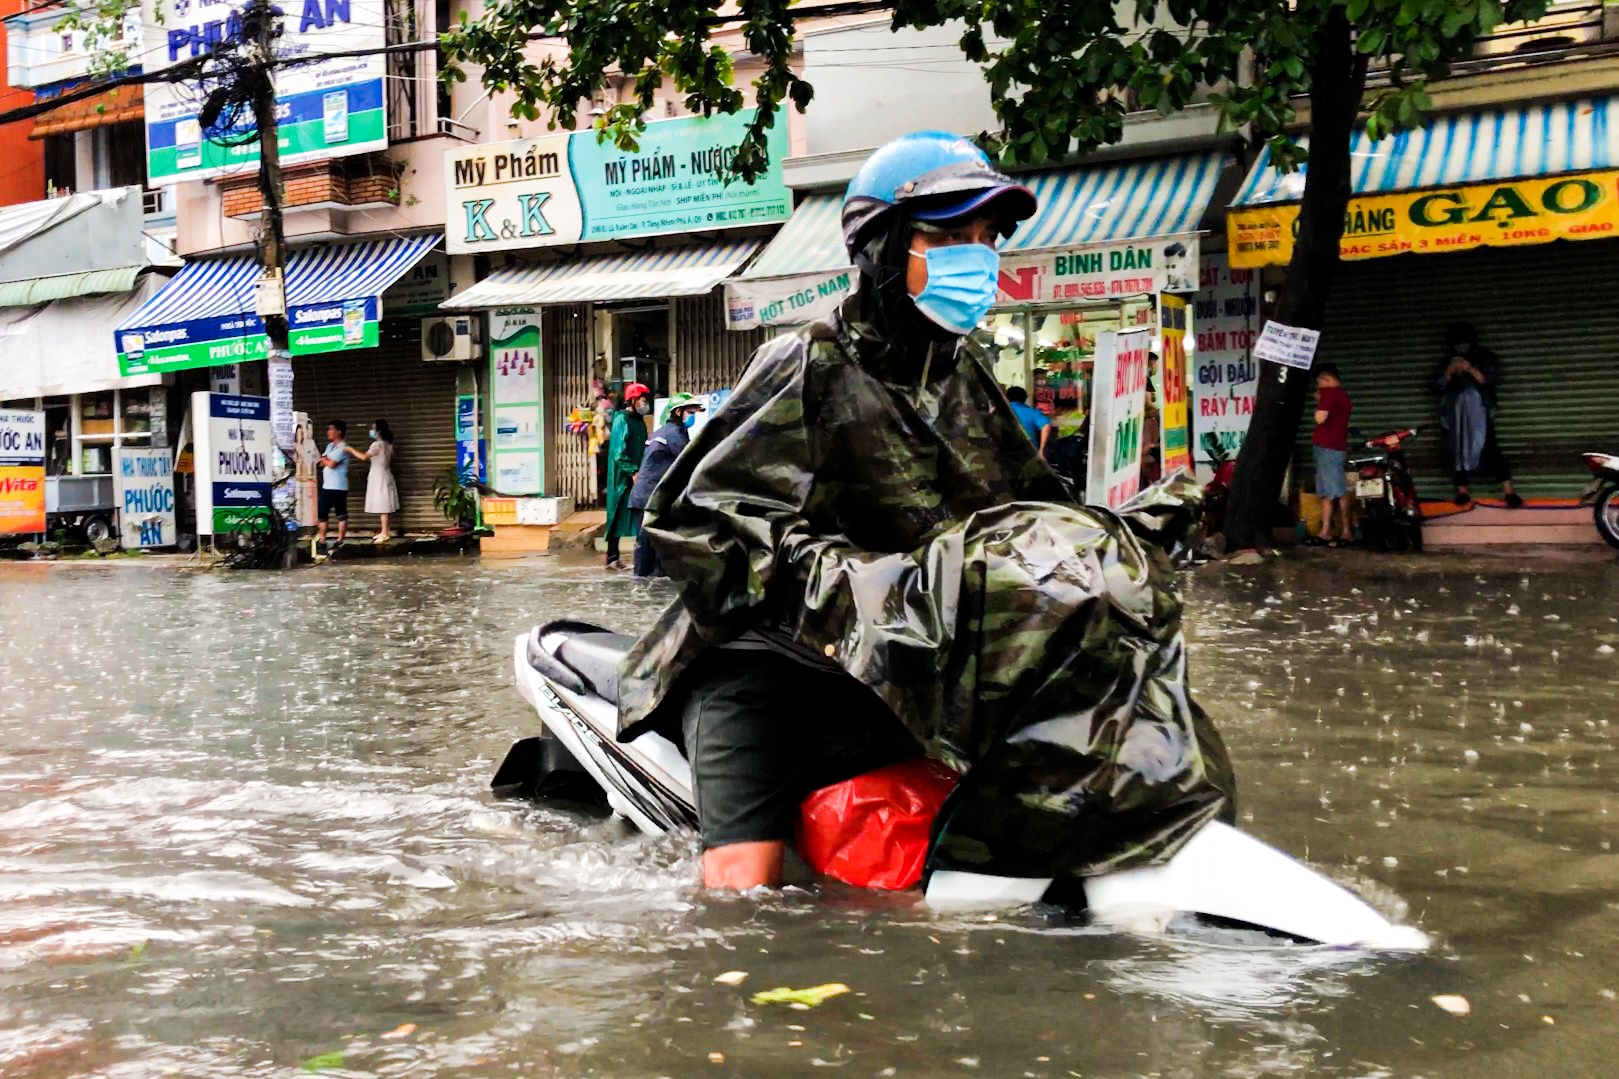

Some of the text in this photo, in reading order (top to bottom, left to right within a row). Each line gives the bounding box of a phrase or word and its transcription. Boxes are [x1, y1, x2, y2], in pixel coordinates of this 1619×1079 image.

[455, 145, 559, 186] Mỹ Phẩm
[605, 156, 627, 186] MỸ
[632, 146, 676, 182] PHẨM
[1408, 178, 1602, 229] GẠO
[1568, 221, 1614, 234] GIAO
[1055, 245, 1152, 276] BÌNH DÂN
[817, 272, 850, 299] NAM
[294, 307, 343, 325] Salonpas
[1201, 392, 1229, 416] RÁY
[25, 432, 42, 450] AN
[125, 482, 173, 513] PHƯỚC
[140, 520, 163, 545] AN
[538, 684, 604, 747] BLADE
